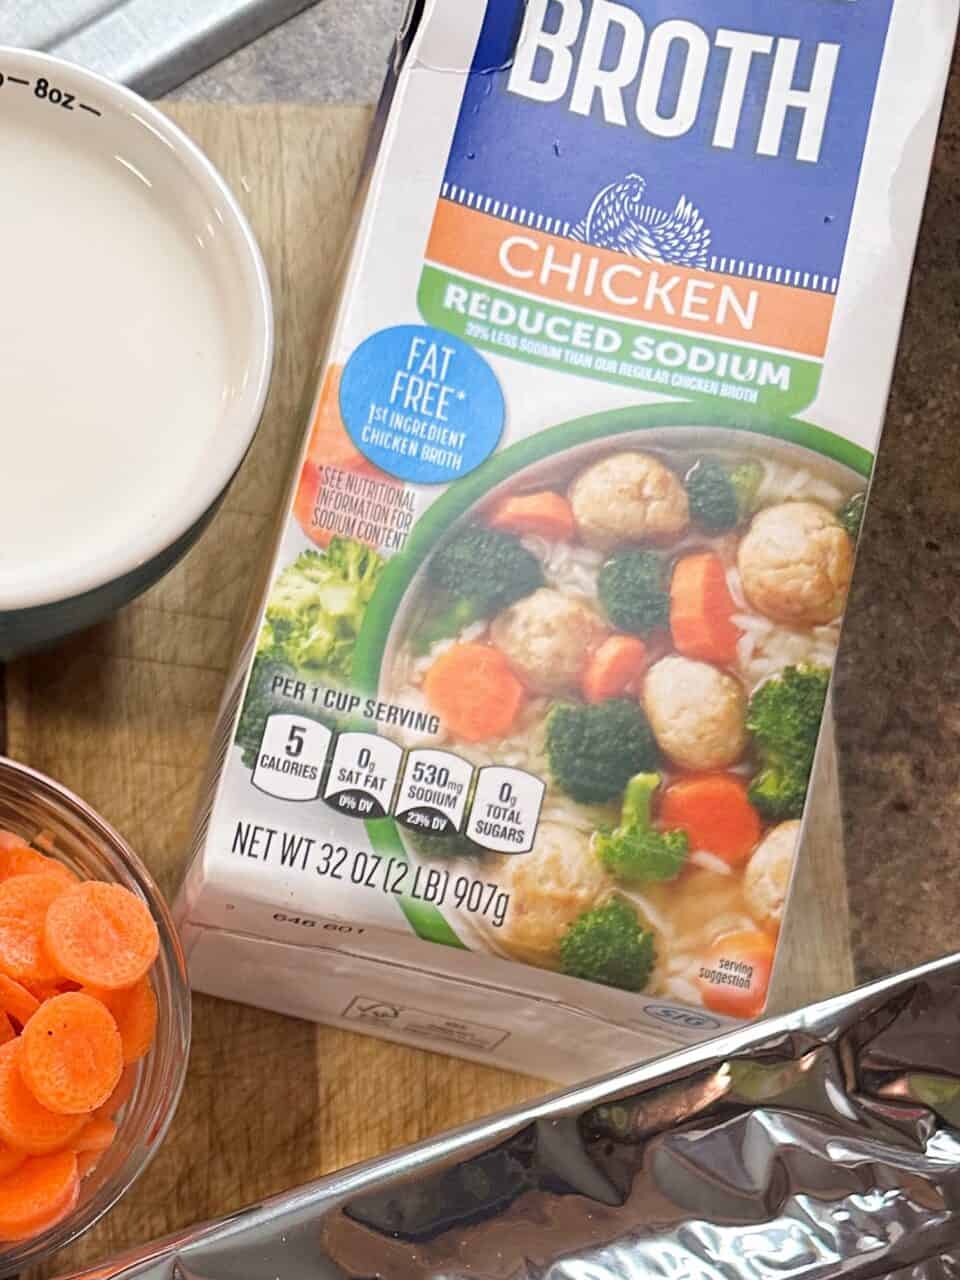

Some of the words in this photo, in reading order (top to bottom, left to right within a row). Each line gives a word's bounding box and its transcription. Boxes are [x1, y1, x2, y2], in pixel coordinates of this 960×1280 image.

[507, 0, 840, 163] BROTH
[499, 235, 758, 330] CHICKEN
[443, 283, 622, 353] REDUCED
[631, 335, 792, 391] SODIUM
[407, 336, 456, 381] FAT
[490, 329, 518, 349] LESS
[519, 338, 561, 360] SODIUM
[564, 347, 593, 369] THAN
[594, 356, 618, 374] OUR
[619, 361, 670, 385] REGULAR
[671, 372, 720, 396] CHICKEN
[720, 381, 759, 404] BROTH
[390, 411, 467, 449] INGREDIENT
[361, 425, 417, 457] CHICKEN
[420, 445, 463, 471] BROTH
[317, 487, 390, 523] INFORMATION
[391, 508, 414, 530] FOR
[345, 479, 416, 512] NUTRITIONAL
[312, 507, 357, 536] SODIUM
[357, 521, 409, 552] CONTENT
[272, 675, 307, 701] PER
[311, 687, 319, 703] 1
[324, 689, 360, 713] CUP
[363, 700, 441, 735] SERVING
[285, 725, 307, 757] 5
[260, 754, 319, 780] CALORIES
[337, 768, 361, 786] SAT
[363, 775, 387, 792] FAT
[411, 762, 464, 795] 530mg
[358, 799, 374, 813] DV
[407, 785, 459, 809] SODIUM
[431, 817, 449, 831] DV
[486, 803, 522, 825] TOTAL
[475, 820, 525, 844] SUGARS
[231, 821, 278, 862] NET
[279, 832, 316, 871] WT
[316, 842, 349, 880] 32
[351, 851, 383, 889] OZ
[382, 857, 409, 895] (2
[411, 865, 450, 907] LB)
[454, 876, 510, 928] 907g
[699, 967, 751, 990] suggestion
[719, 958, 753, 978] serving
